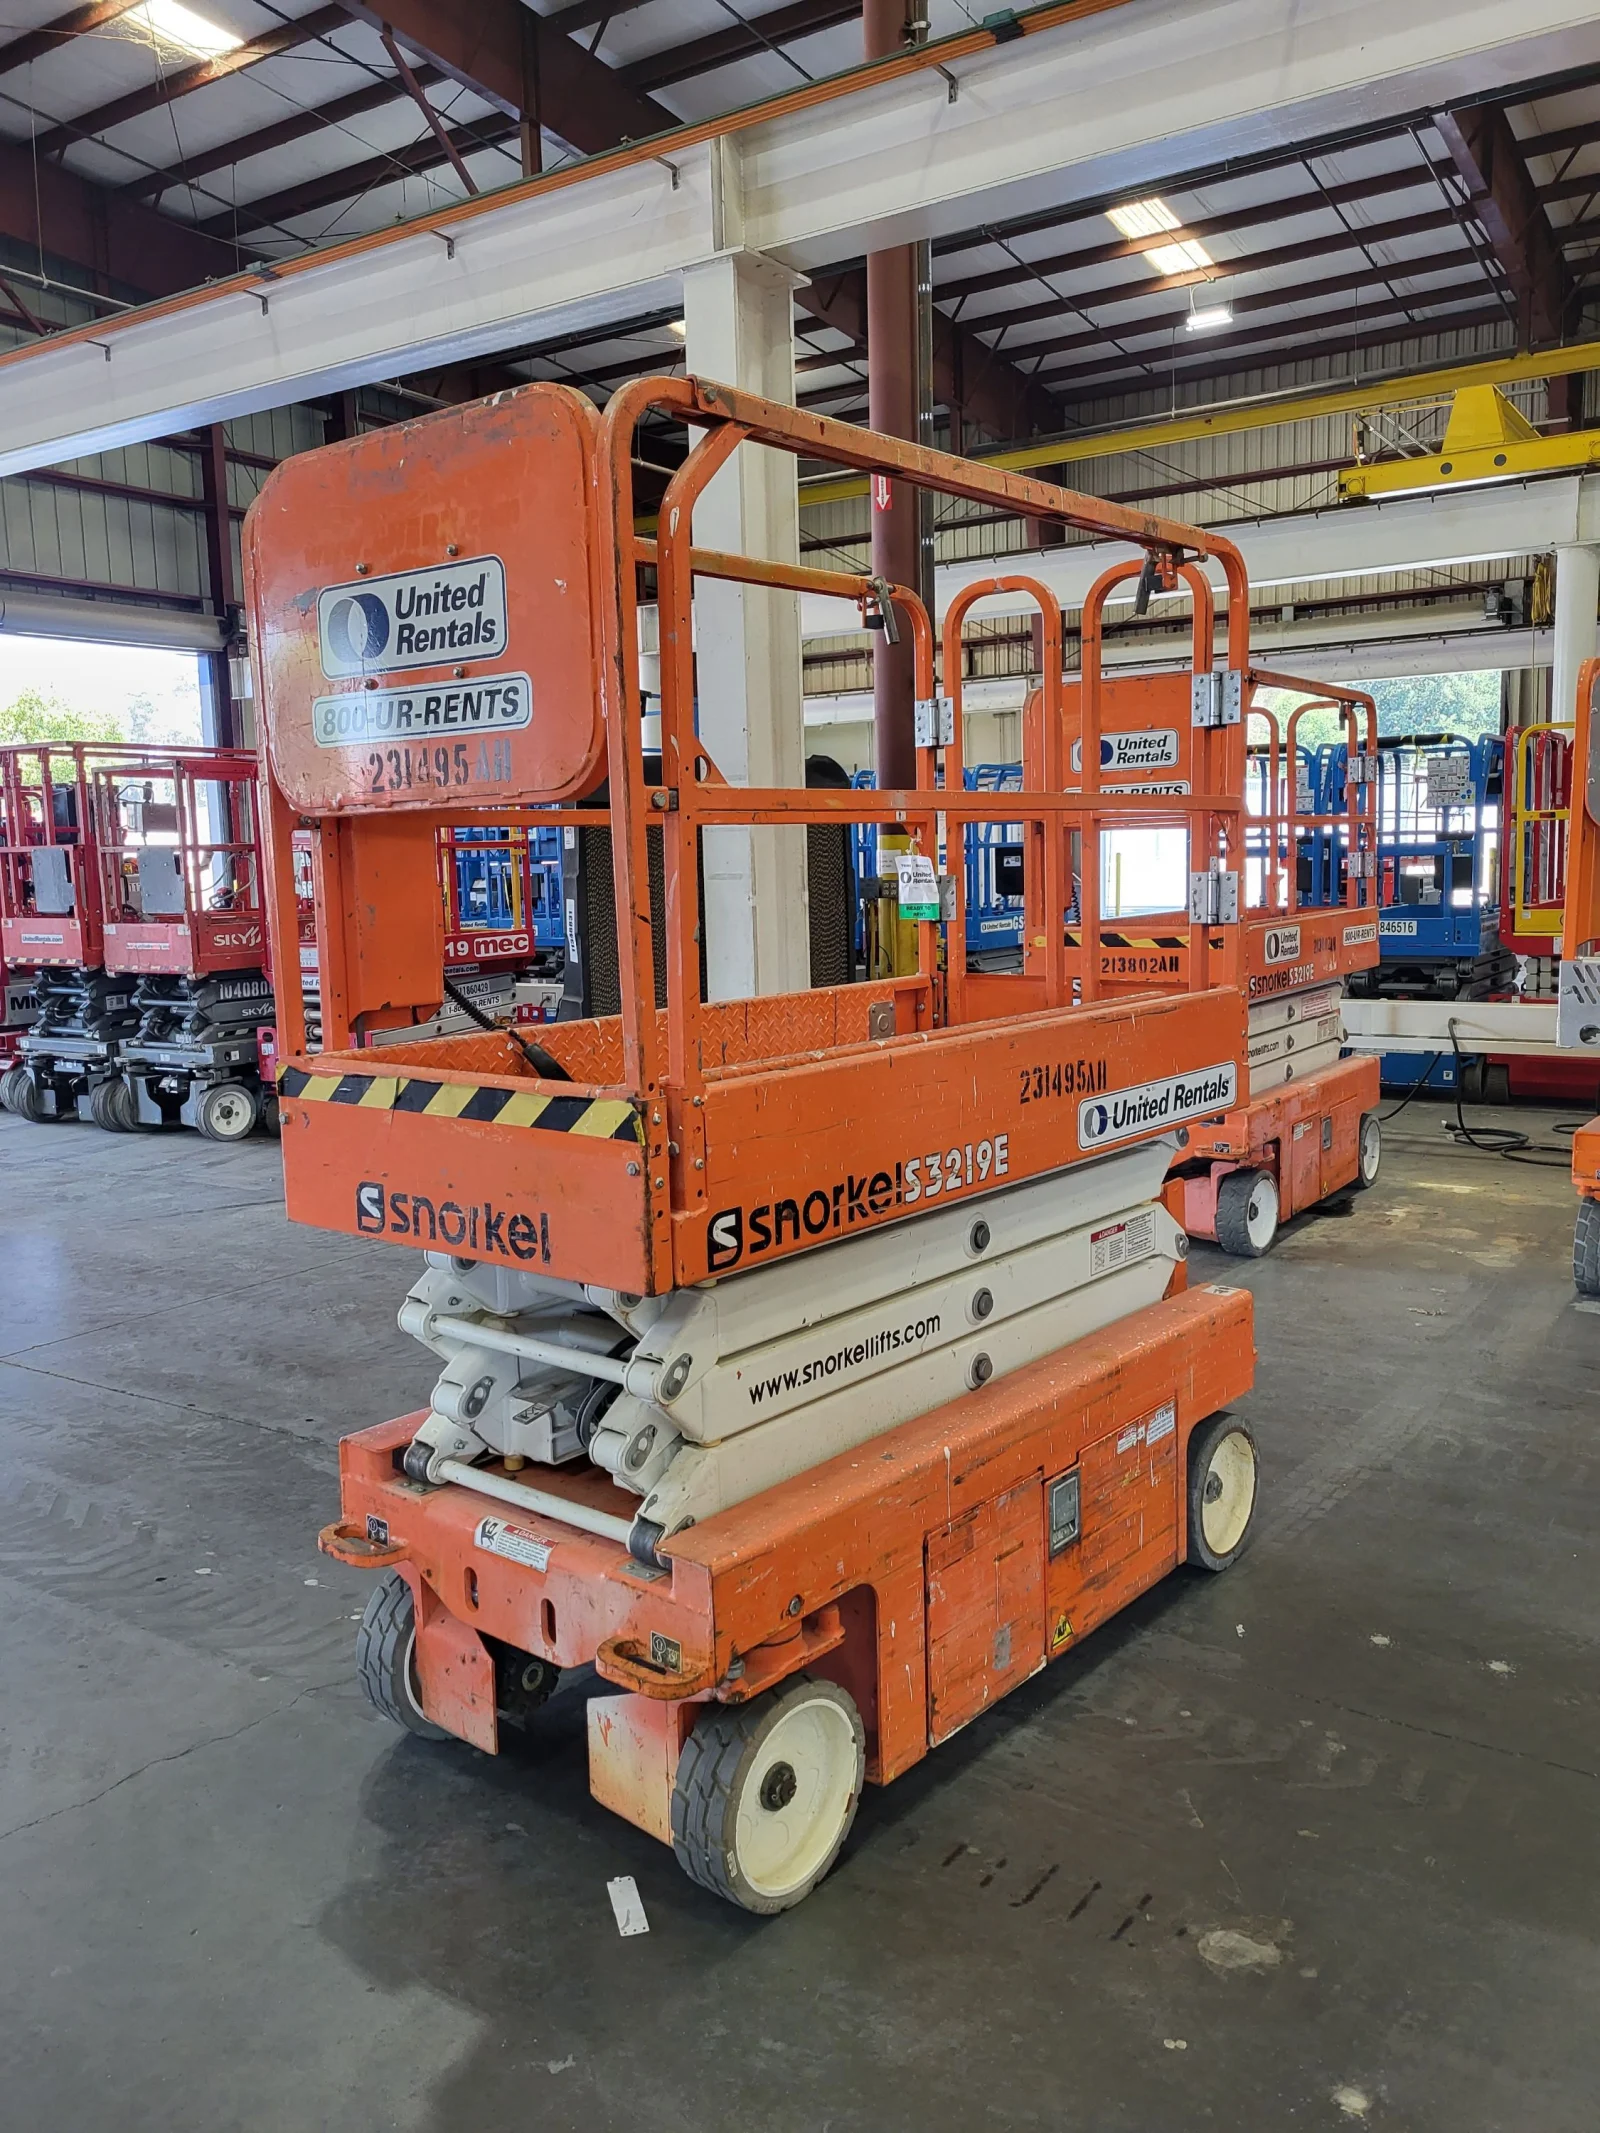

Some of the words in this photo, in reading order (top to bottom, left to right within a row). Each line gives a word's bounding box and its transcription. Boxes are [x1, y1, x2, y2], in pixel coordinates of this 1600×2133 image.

[395, 572, 486, 620] United
[396, 611, 497, 656] Rentals
[322, 685, 520, 737] 800-UR-RENTS
[1116, 735, 1169, 751] United
[1116, 749, 1173, 765] Rentals
[1280, 929, 1298, 944] United
[1379, 921, 1414, 933] 846516
[444, 939, 469, 958] 19
[475, 936, 528, 955] mec
[1101, 955, 1179, 973] 213802AH
[1256, 968, 1290, 995] snorkel
[1019, 1059, 1107, 1105] 231495AH
[1112, 1088, 1170, 1130] United
[1173, 1073, 1230, 1112] Rentals
[749, 1162, 903, 1254] snorkel
[903, 1133, 1009, 1204] S3219E
[389, 1191, 551, 1264] snorkel
[748, 1313, 941, 1406] www.snorkellifts.com
[518, 1530, 549, 1545] DANGER
